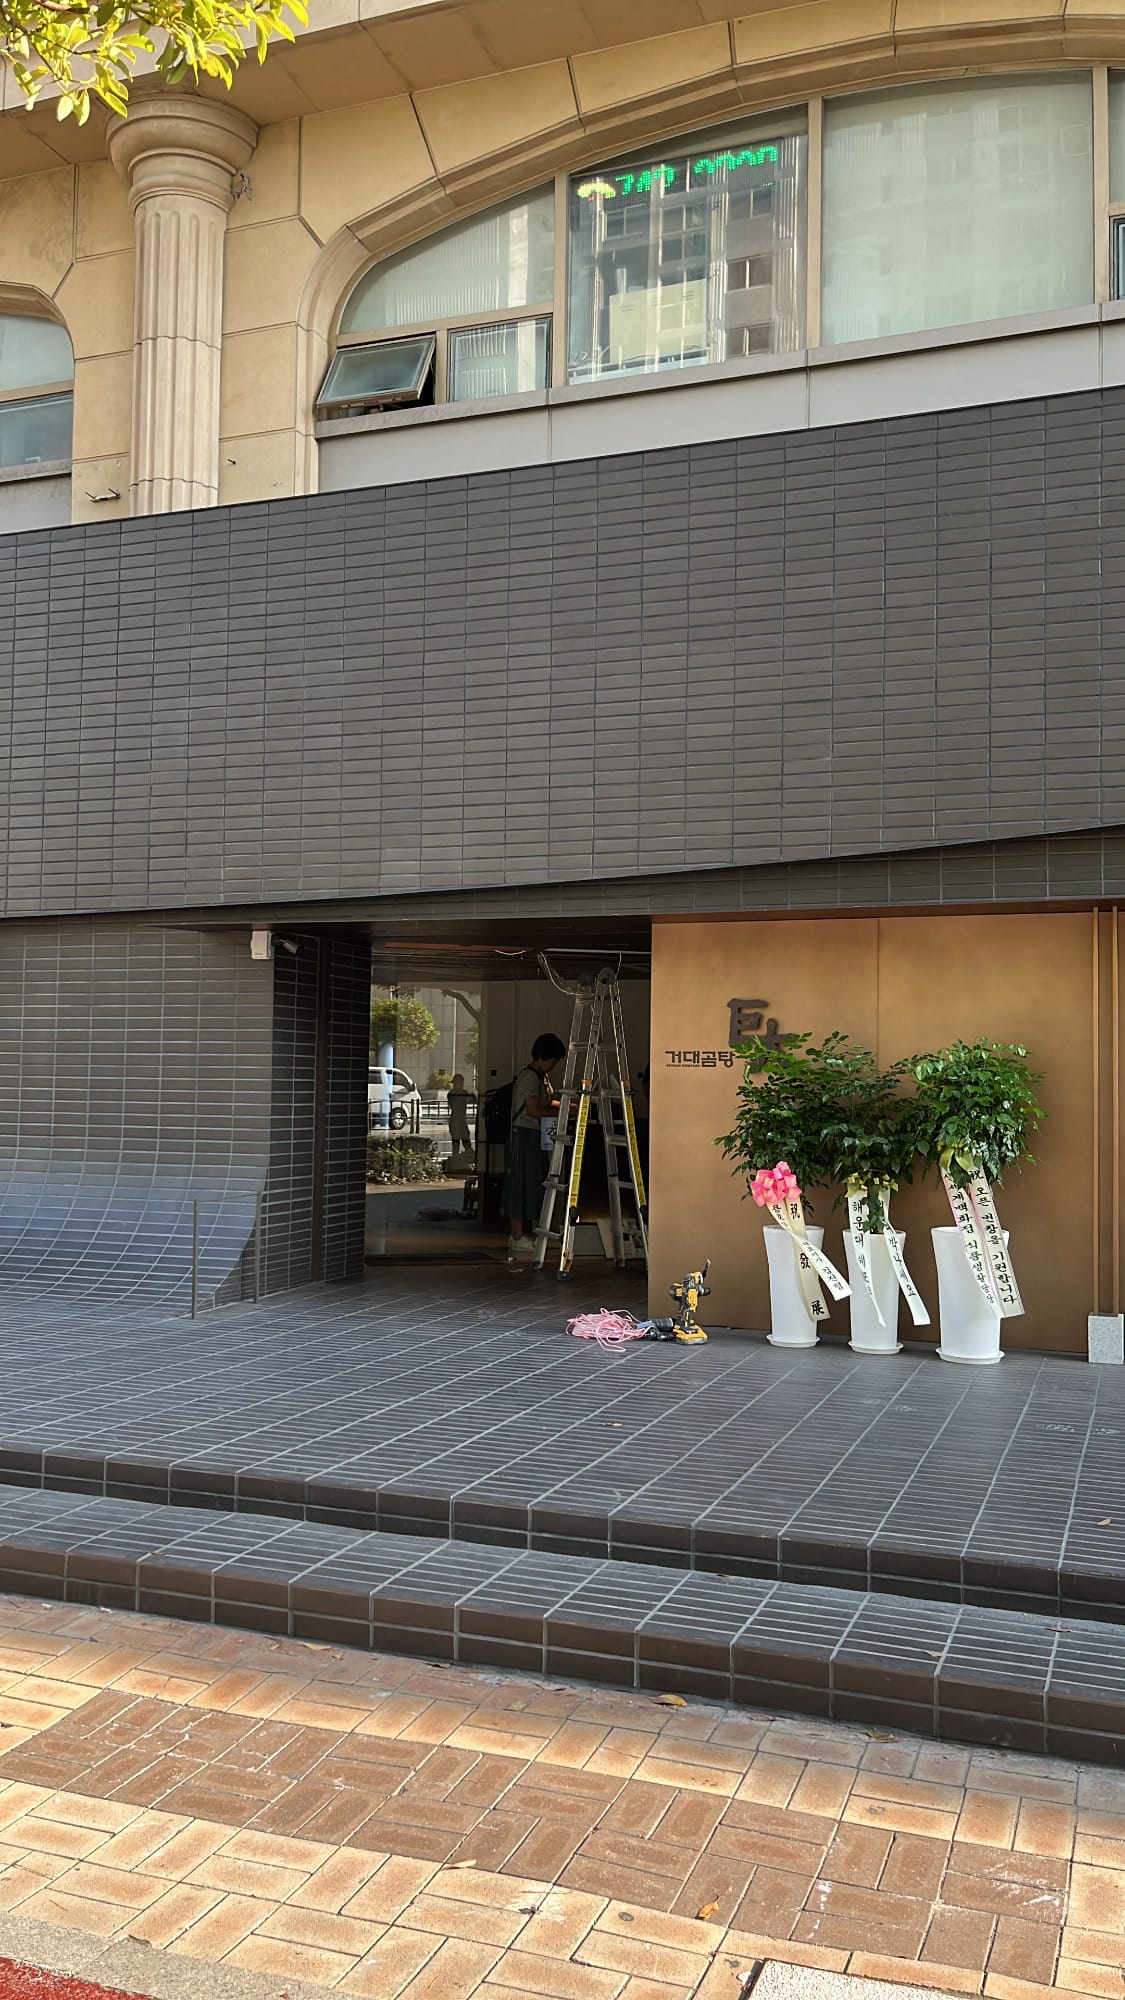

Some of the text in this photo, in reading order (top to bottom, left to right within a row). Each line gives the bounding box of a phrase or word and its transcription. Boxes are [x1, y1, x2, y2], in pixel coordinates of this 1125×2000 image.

[665, 1051, 736, 1068] 거대곰탕
[852, 1199, 865, 1247] 해운대
[975, 1187, 1017, 1305] 오픈 번창을 기원합니다
